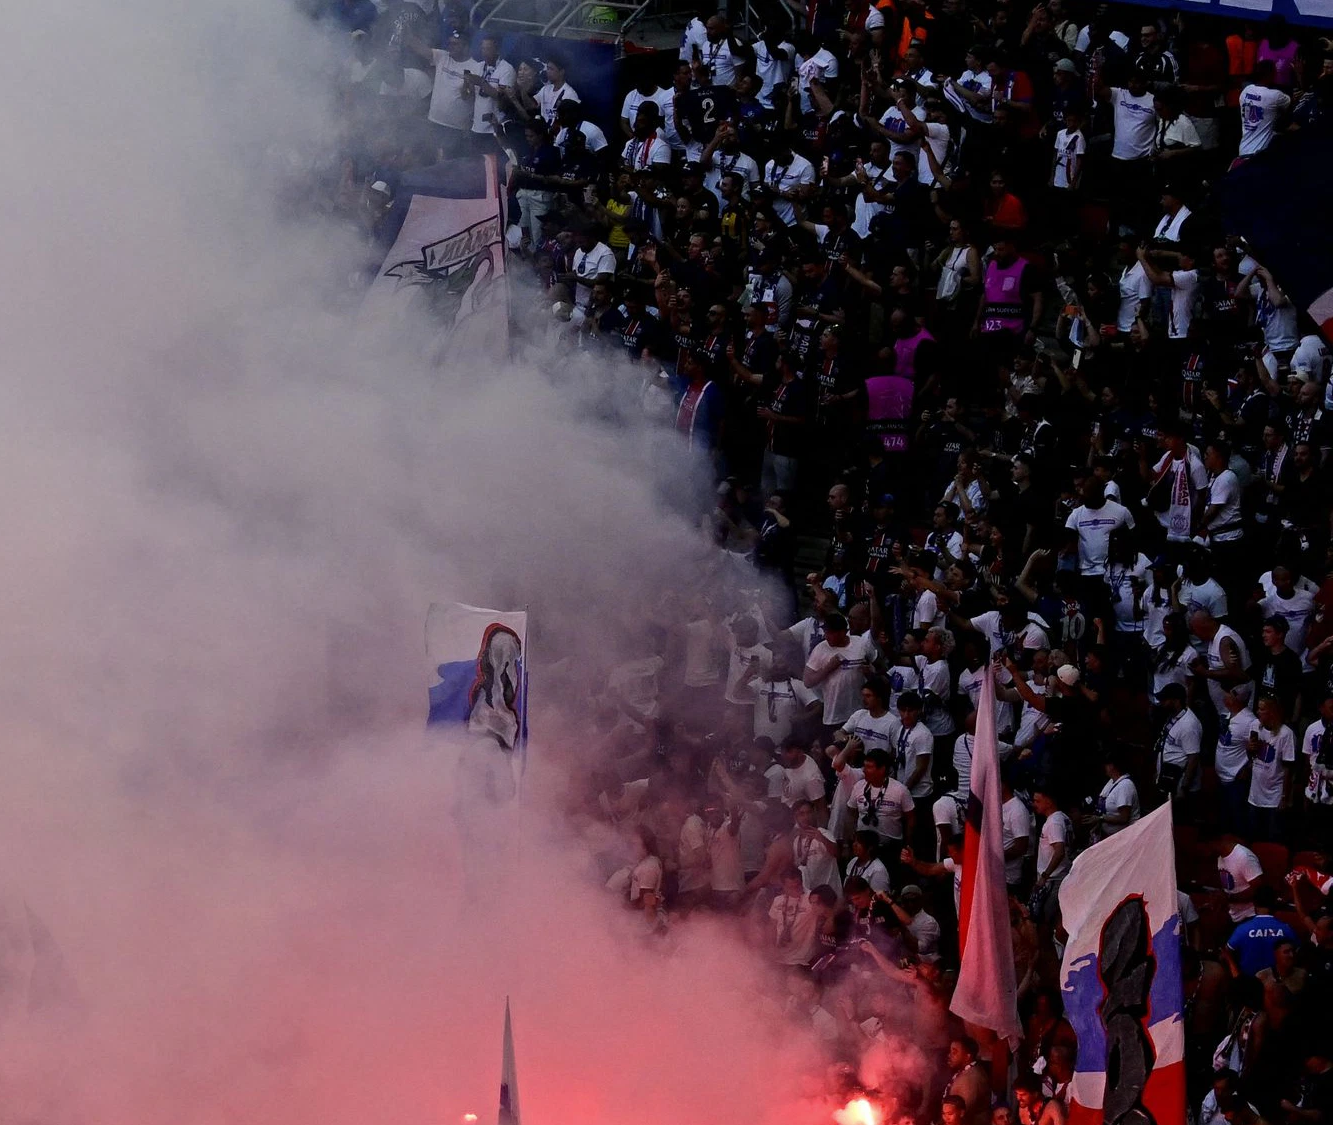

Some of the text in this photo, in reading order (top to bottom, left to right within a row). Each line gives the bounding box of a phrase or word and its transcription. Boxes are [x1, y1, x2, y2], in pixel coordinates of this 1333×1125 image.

[701, 98, 715, 123] 2
[1060, 612, 1085, 642] 10
[1248, 927, 1285, 939] CAIXA
